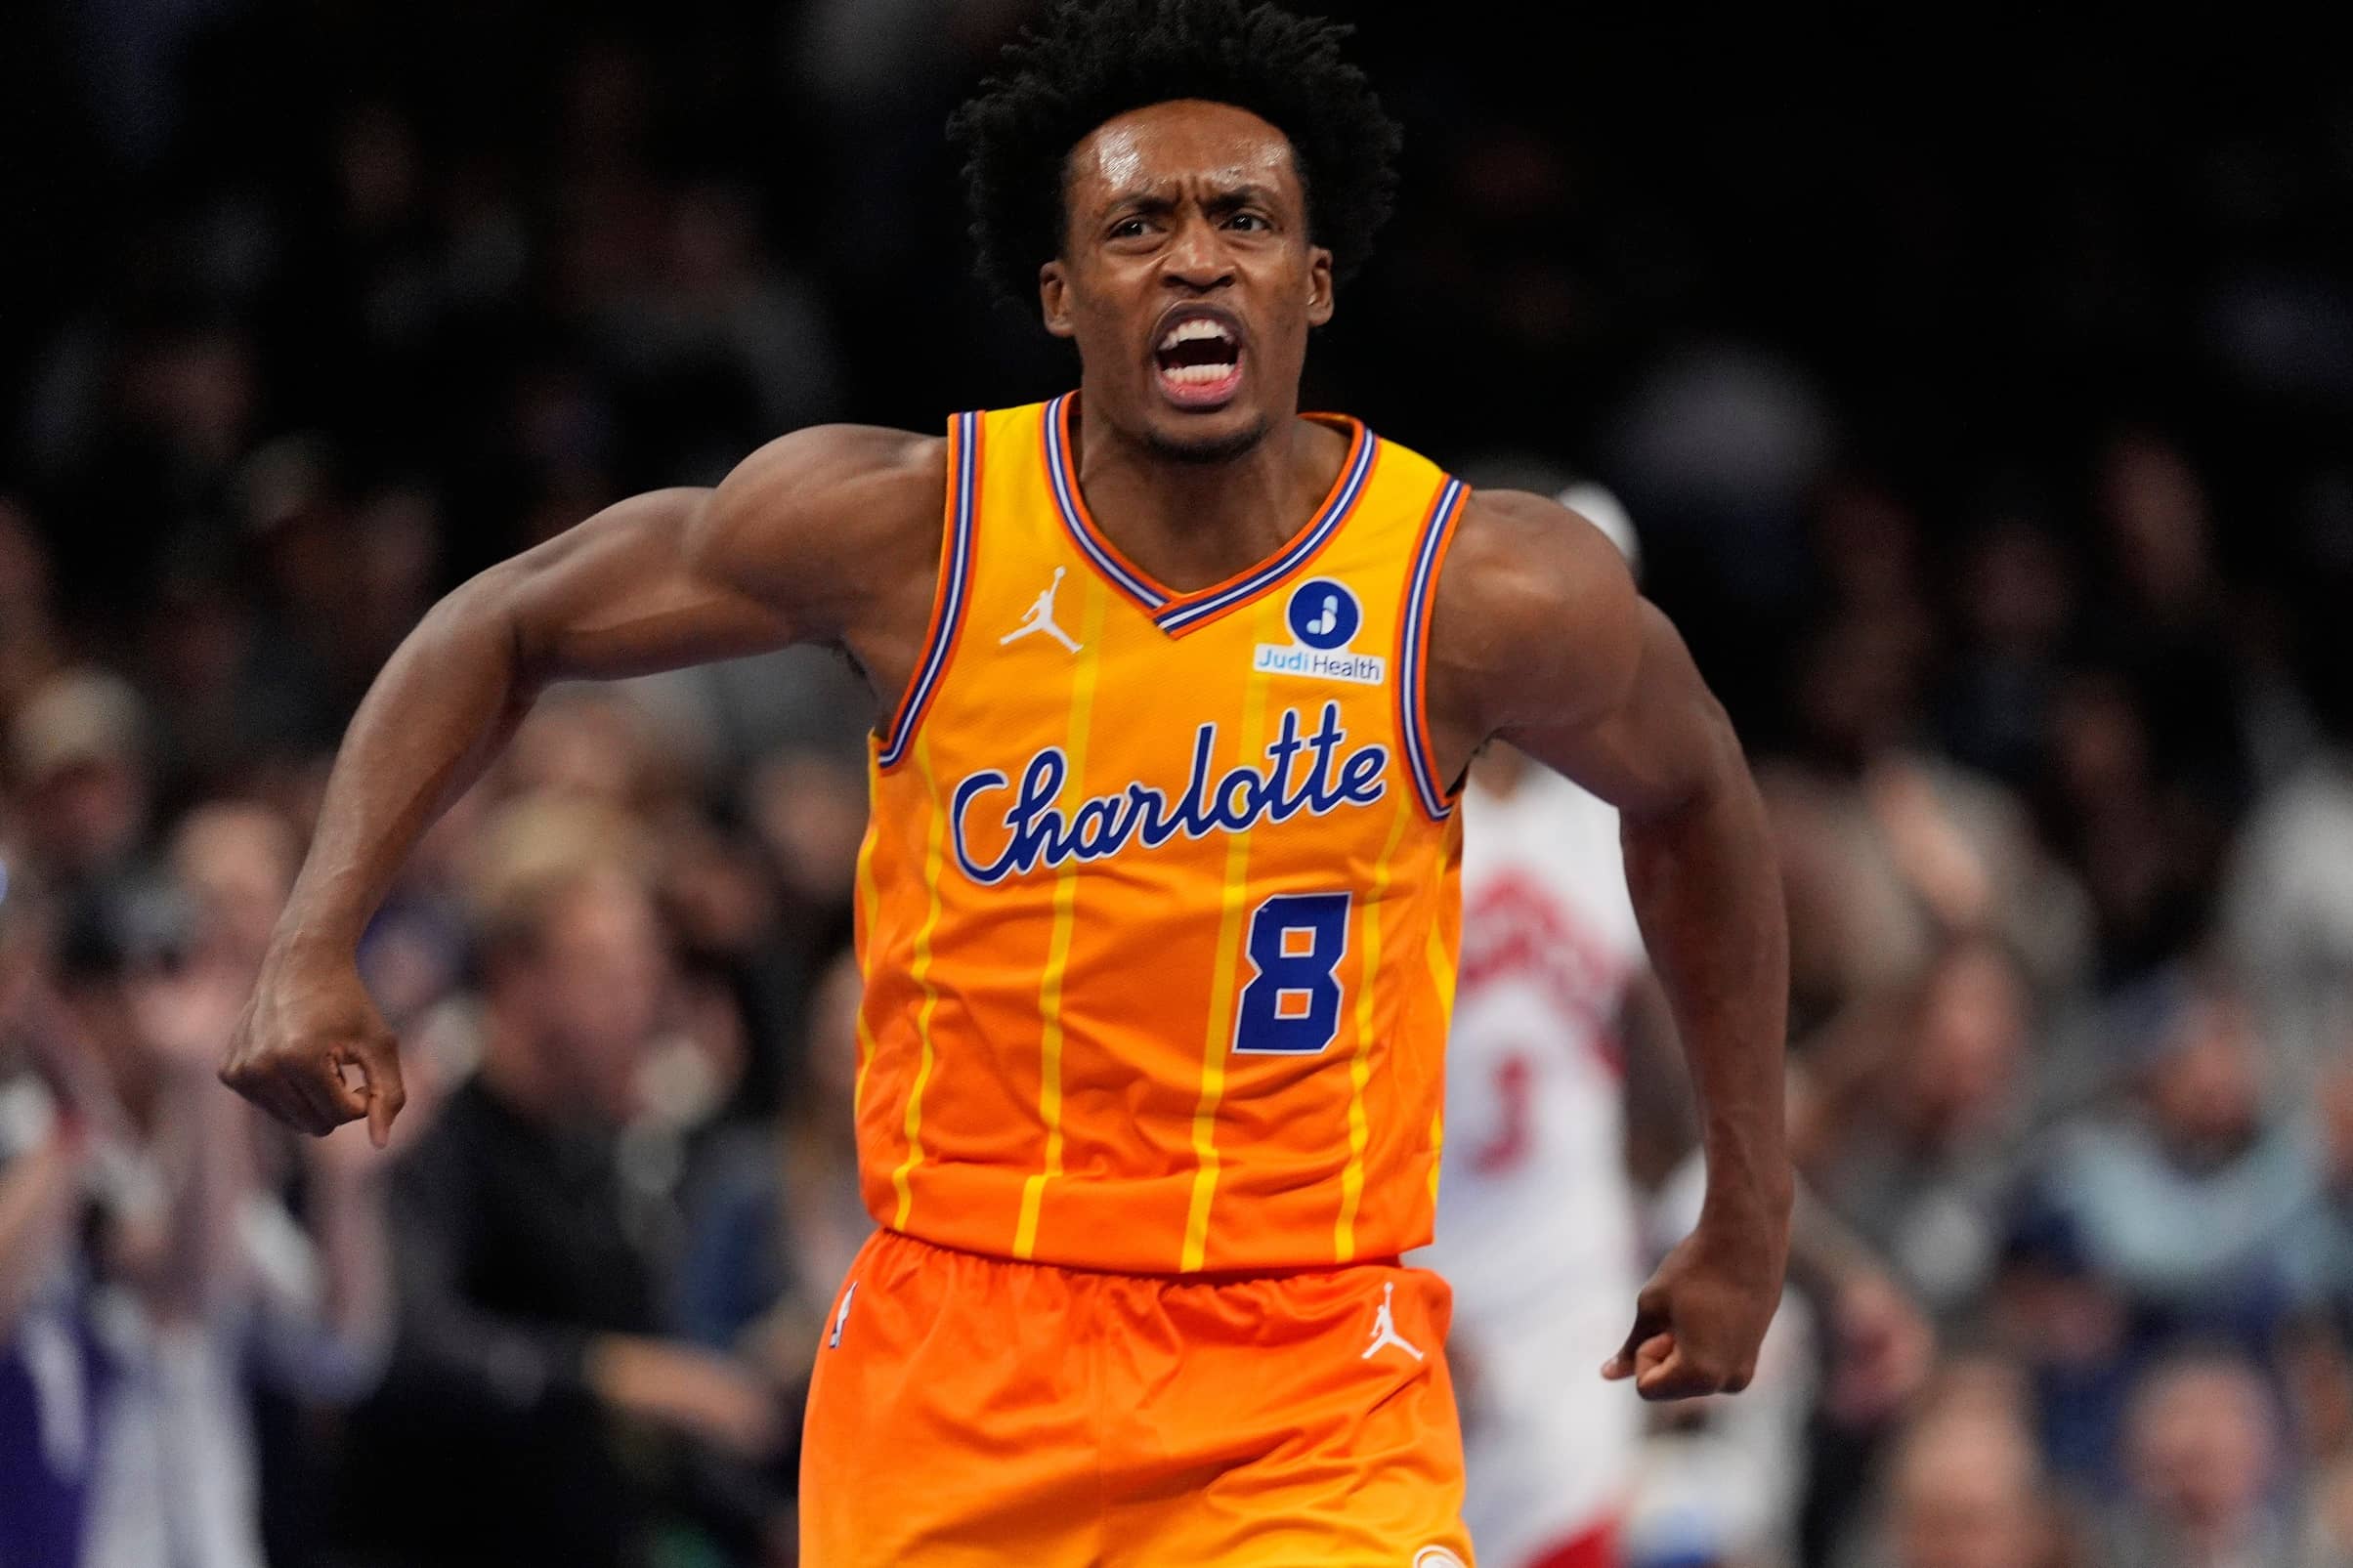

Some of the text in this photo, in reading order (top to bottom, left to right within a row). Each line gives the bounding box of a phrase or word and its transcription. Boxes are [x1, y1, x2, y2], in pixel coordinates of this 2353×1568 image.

[1258, 650, 1380, 680] Judi Health
[951, 699, 1390, 885] Charlotte
[1231, 890, 1353, 1056] 8
